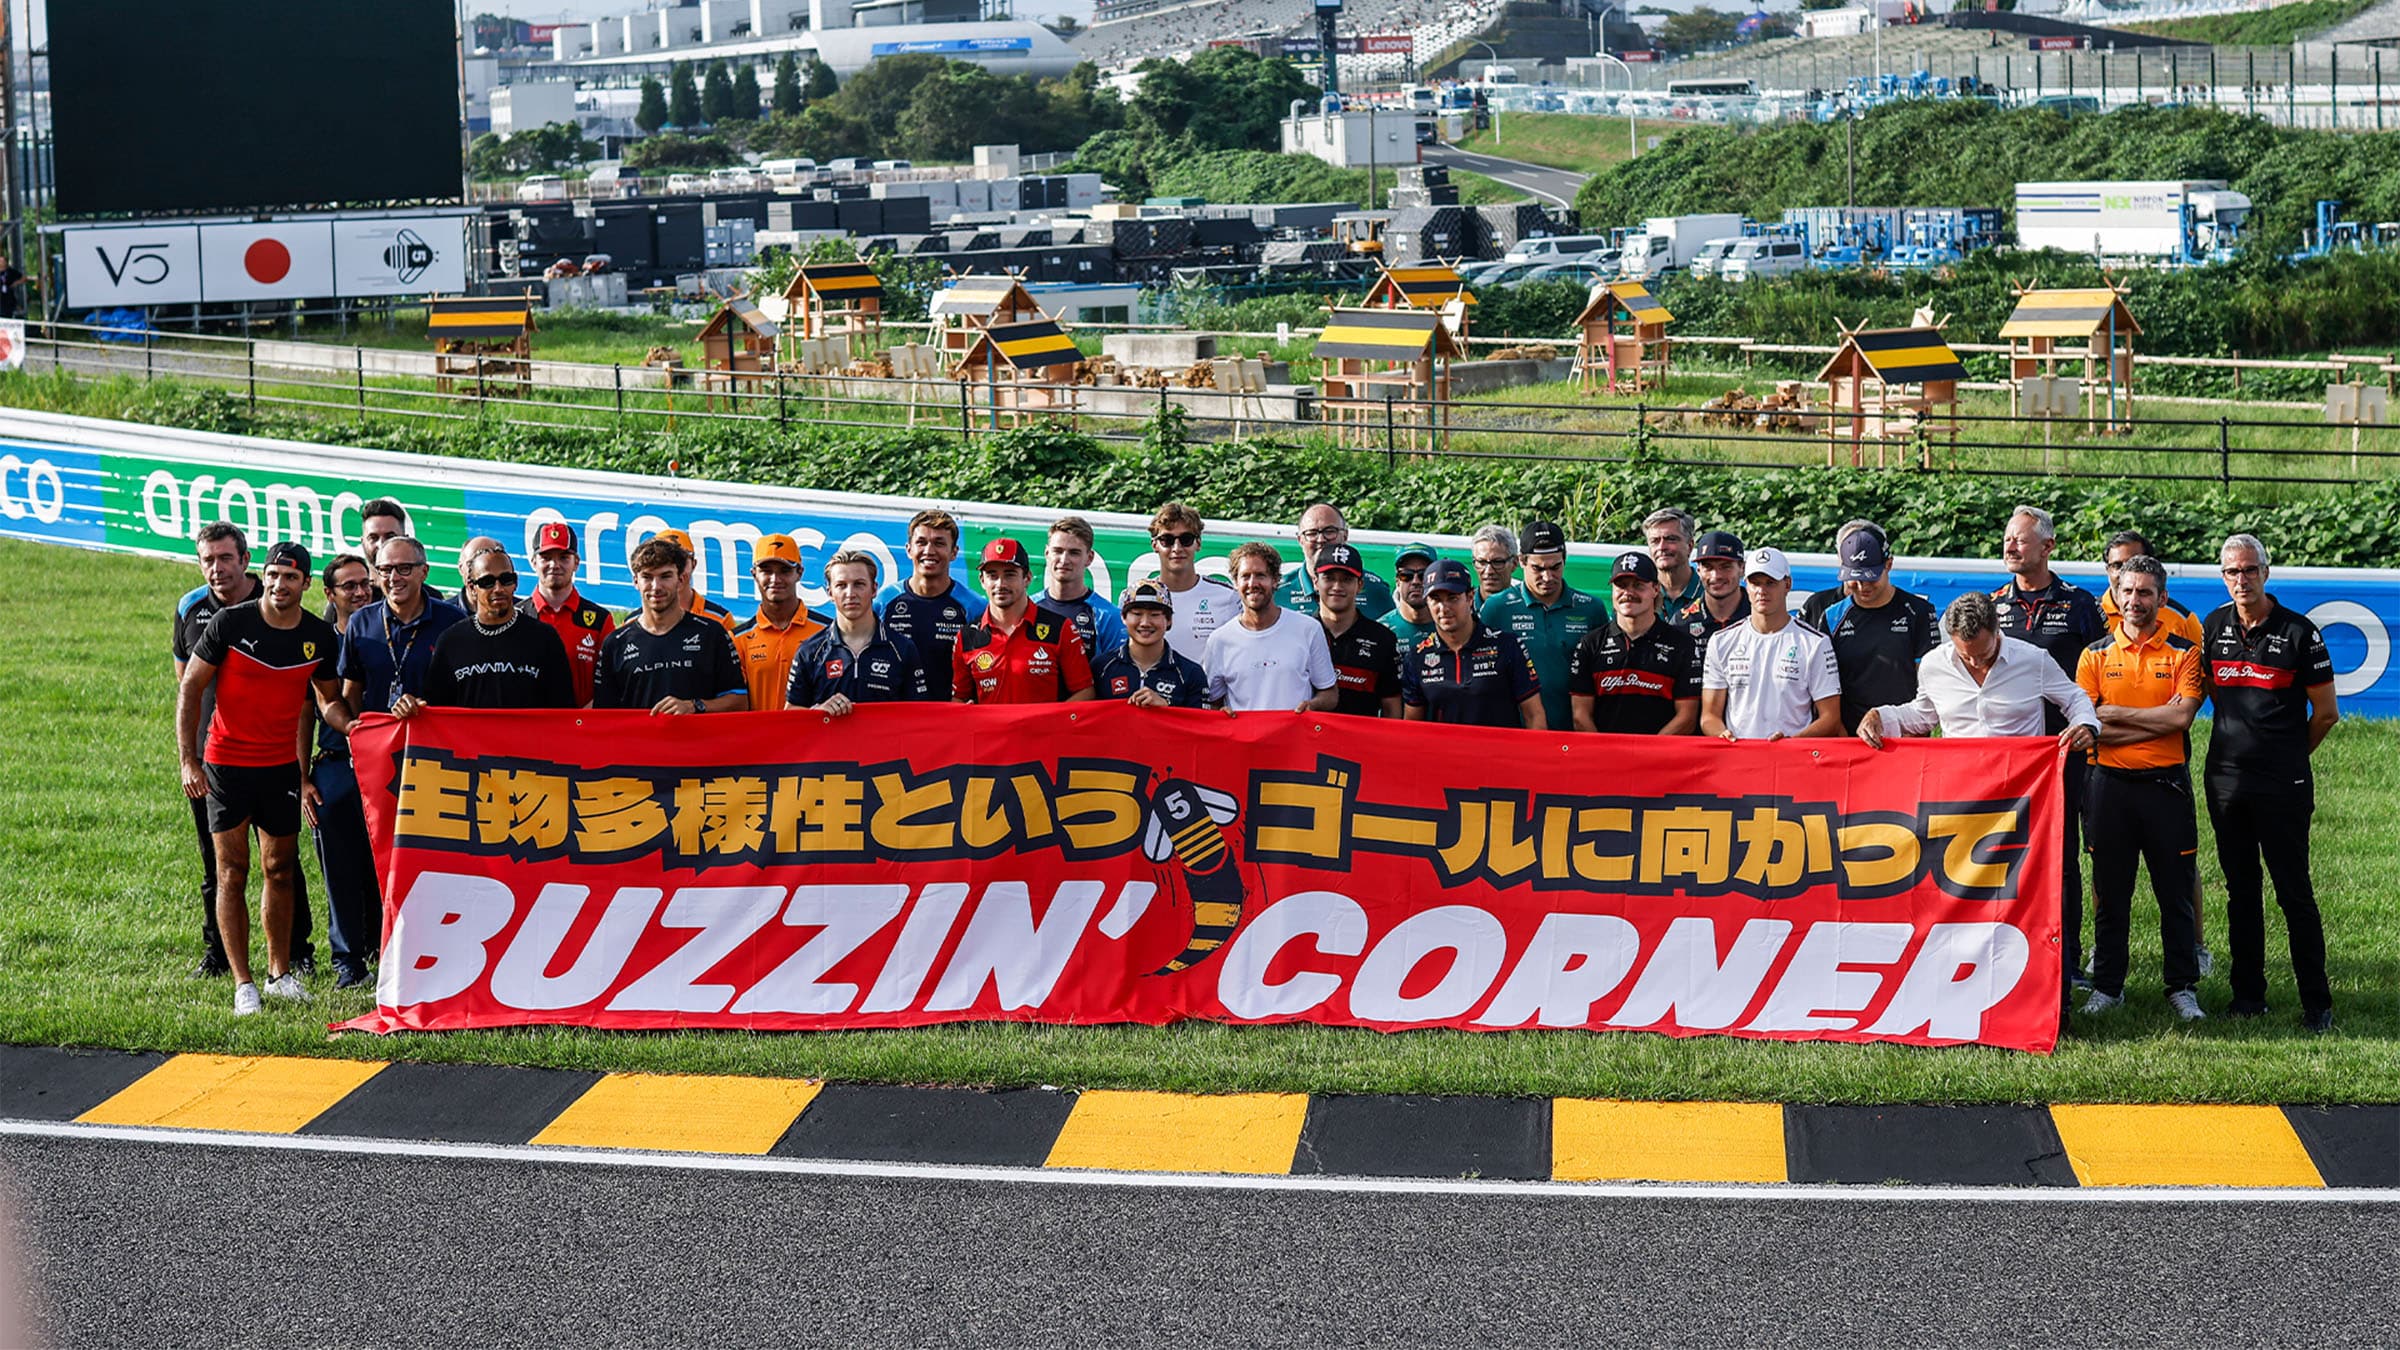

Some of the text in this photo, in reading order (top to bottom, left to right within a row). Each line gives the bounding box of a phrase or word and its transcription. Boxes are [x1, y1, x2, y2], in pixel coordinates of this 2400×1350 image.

[1367, 38, 1413, 51] Lenovo
[2104, 196, 2133, 210] NEX
[633, 659, 693, 674] ALPINE
[2217, 666, 2240, 681] Alfa
[2239, 665, 2275, 680] Romeo
[1600, 673, 1663, 691] Alfa Romeo
[1164, 790, 1192, 821] 5
[394, 757, 2017, 887] 生物多様性という ゴールに向かって
[1217, 890, 2030, 1040] CORNER
